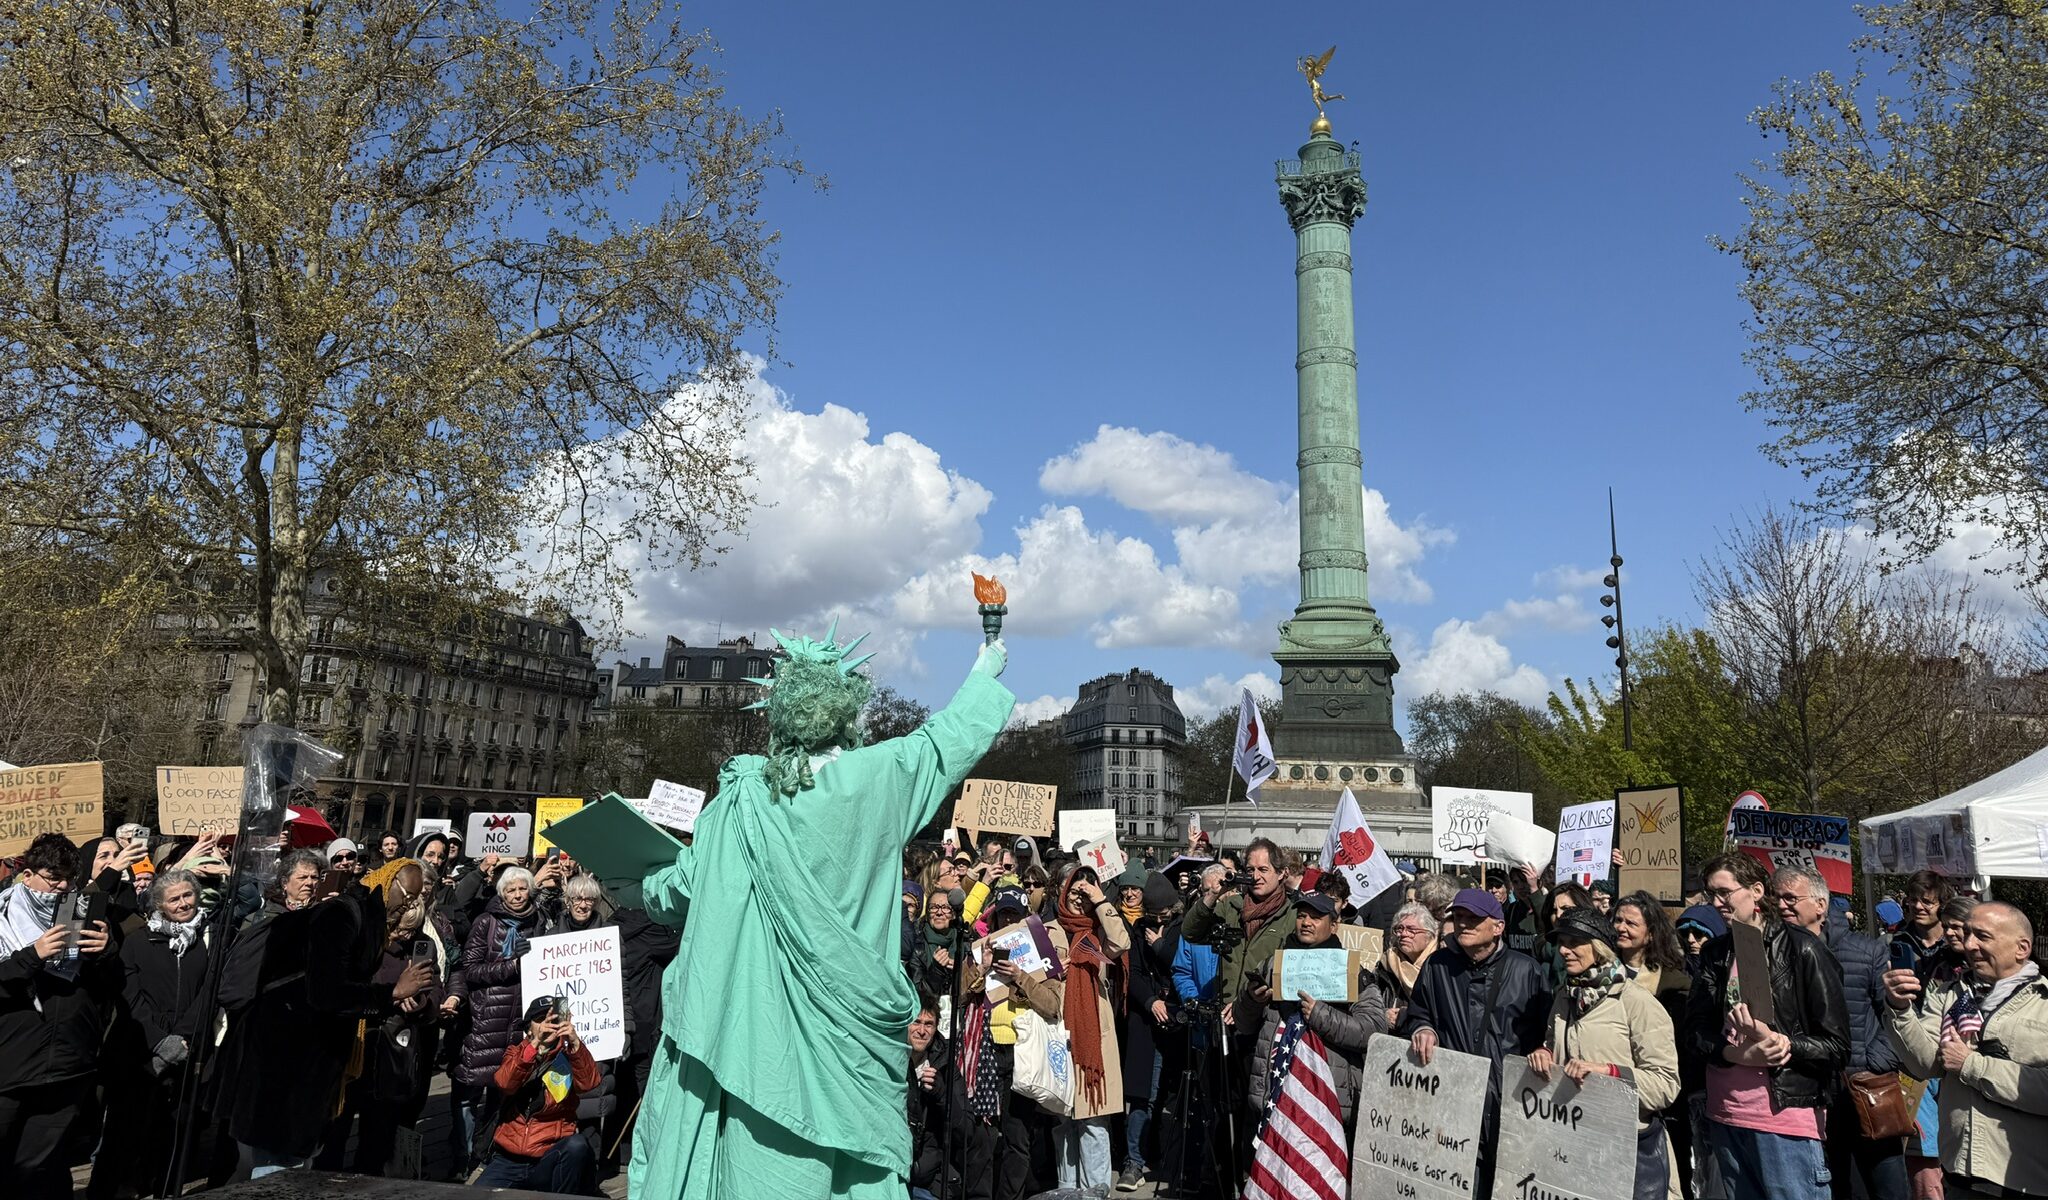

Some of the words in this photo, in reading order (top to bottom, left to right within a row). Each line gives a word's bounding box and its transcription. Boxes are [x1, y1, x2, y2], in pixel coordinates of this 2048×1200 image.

[0, 771, 46, 788] ABUSE
[49, 770, 67, 784] OF
[157, 768, 197, 784] THE
[208, 770, 243, 784] ONL
[0, 787, 62, 804] POWER
[163, 786, 204, 798] GOOD
[207, 789, 241, 799] FASC
[982, 782, 1003, 797] NO
[48, 803, 68, 816] AS
[75, 801, 95, 814] NO
[165, 801, 181, 813] IS
[185, 803, 197, 813] A
[981, 797, 1000, 806] NO
[1004, 798, 1044, 811] LIES
[978, 816, 997, 826] NO
[980, 806, 997, 816] NO
[1002, 807, 1042, 820] CRIMES
[1561, 813, 1577, 831] NO
[1578, 806, 1613, 828] KINGS
[0, 818, 77, 840] SURPRISE
[1621, 817, 1636, 834] NO
[1659, 810, 1680, 831] KINGS
[1736, 812, 1848, 841] DEMOCRACY
[485, 832, 507, 844] NO
[1559, 840, 1581, 852] SINCE
[1583, 839, 1604, 849] 1776
[1771, 836, 1788, 849] IS
[1793, 839, 1825, 851] NOT
[482, 845, 511, 854] KINGS
[1622, 848, 1642, 866] NO
[1648, 848, 1679, 867] WAR
[1783, 849, 1802, 859] FOR
[1355, 872, 1370, 889] de
[588, 958, 612, 974] 1963
[554, 978, 587, 997] AND
[1386, 1058, 1440, 1096] TRUMP
[1521, 1086, 1583, 1131] DUMP
[1370, 1108, 1392, 1132] PAY
[1437, 1132, 1471, 1152] WHAT
[1553, 1146, 1569, 1164] the
[1369, 1141, 1388, 1164] YOU
[1392, 1153, 1419, 1172] HAVE
[1425, 1165, 1447, 1182] COST
[1449, 1172, 1469, 1190] THE
[1396, 1180, 1416, 1198] USA
